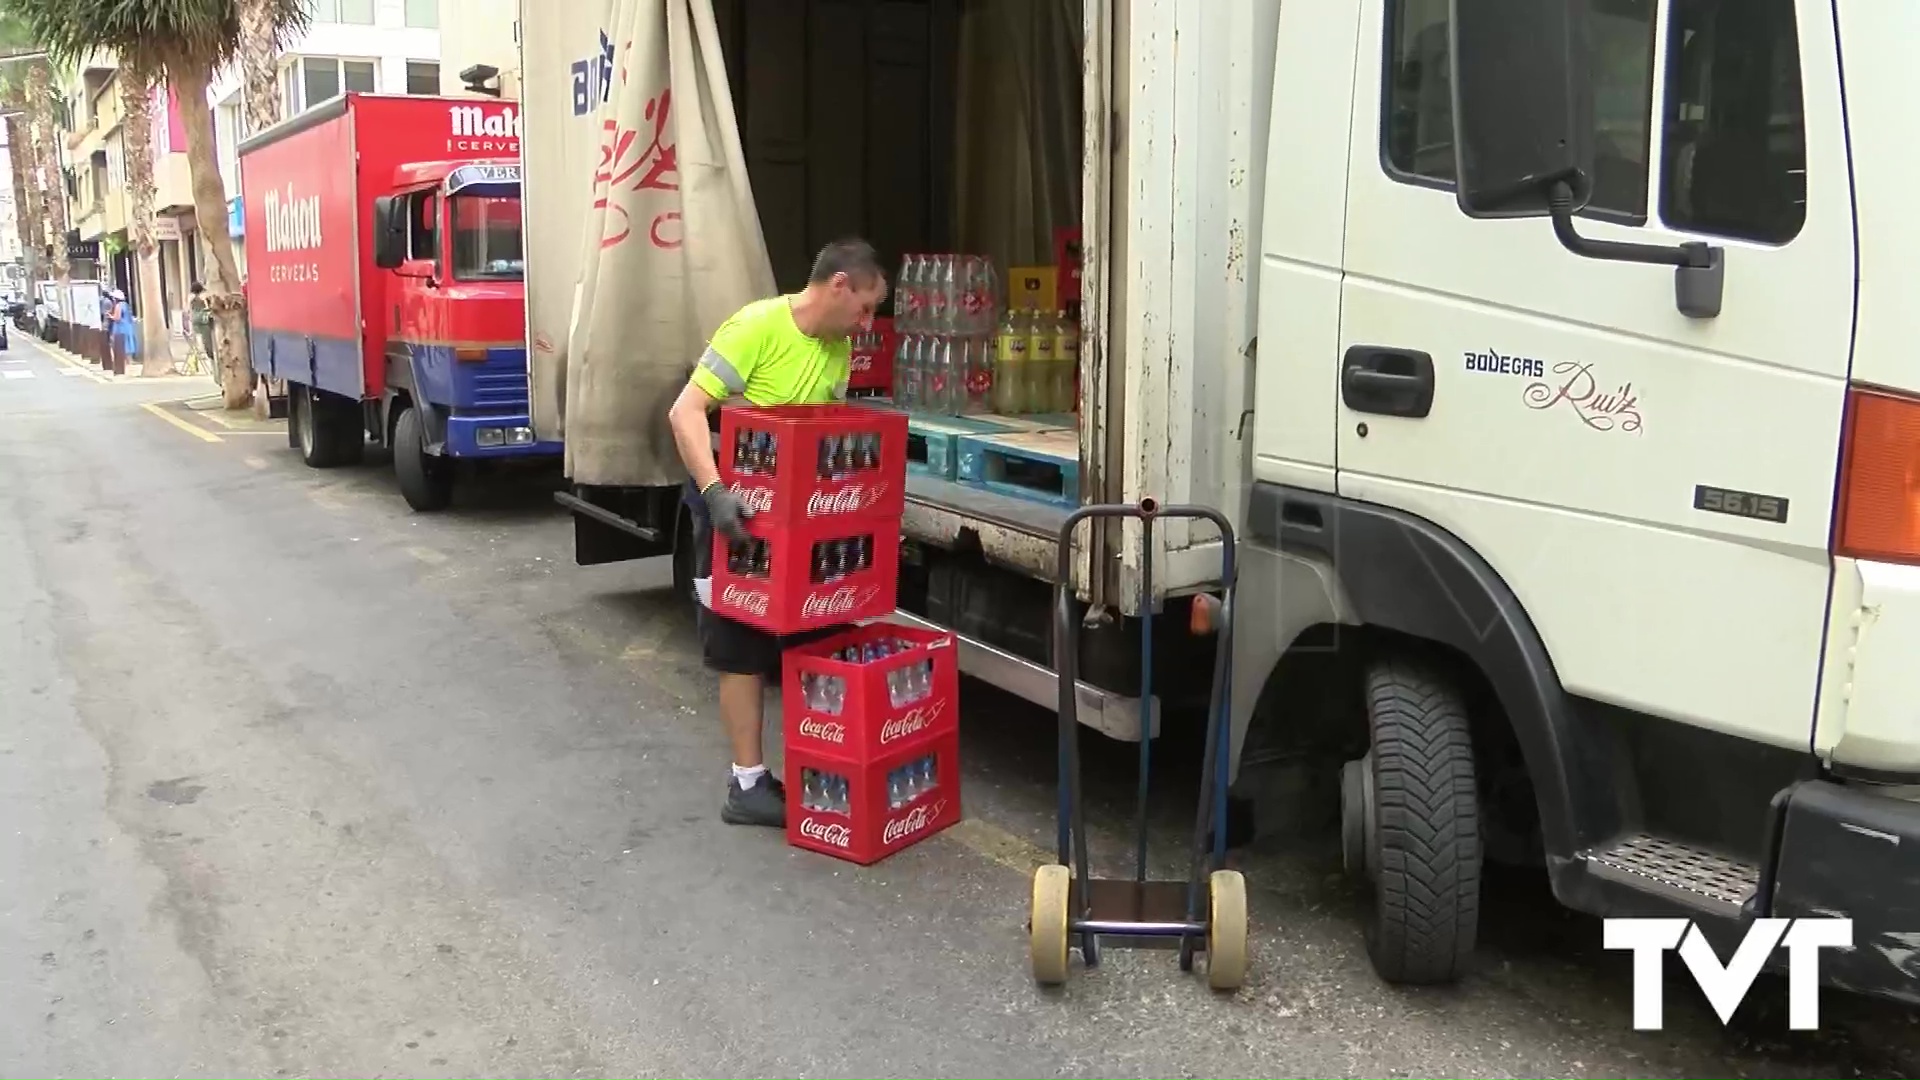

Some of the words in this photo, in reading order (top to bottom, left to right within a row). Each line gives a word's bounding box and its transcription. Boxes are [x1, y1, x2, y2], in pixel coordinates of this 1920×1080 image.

[264, 181, 322, 253] Mahou
[270, 263, 320, 283] CERVEZAS
[1464, 347, 1544, 377] BODEGAS
